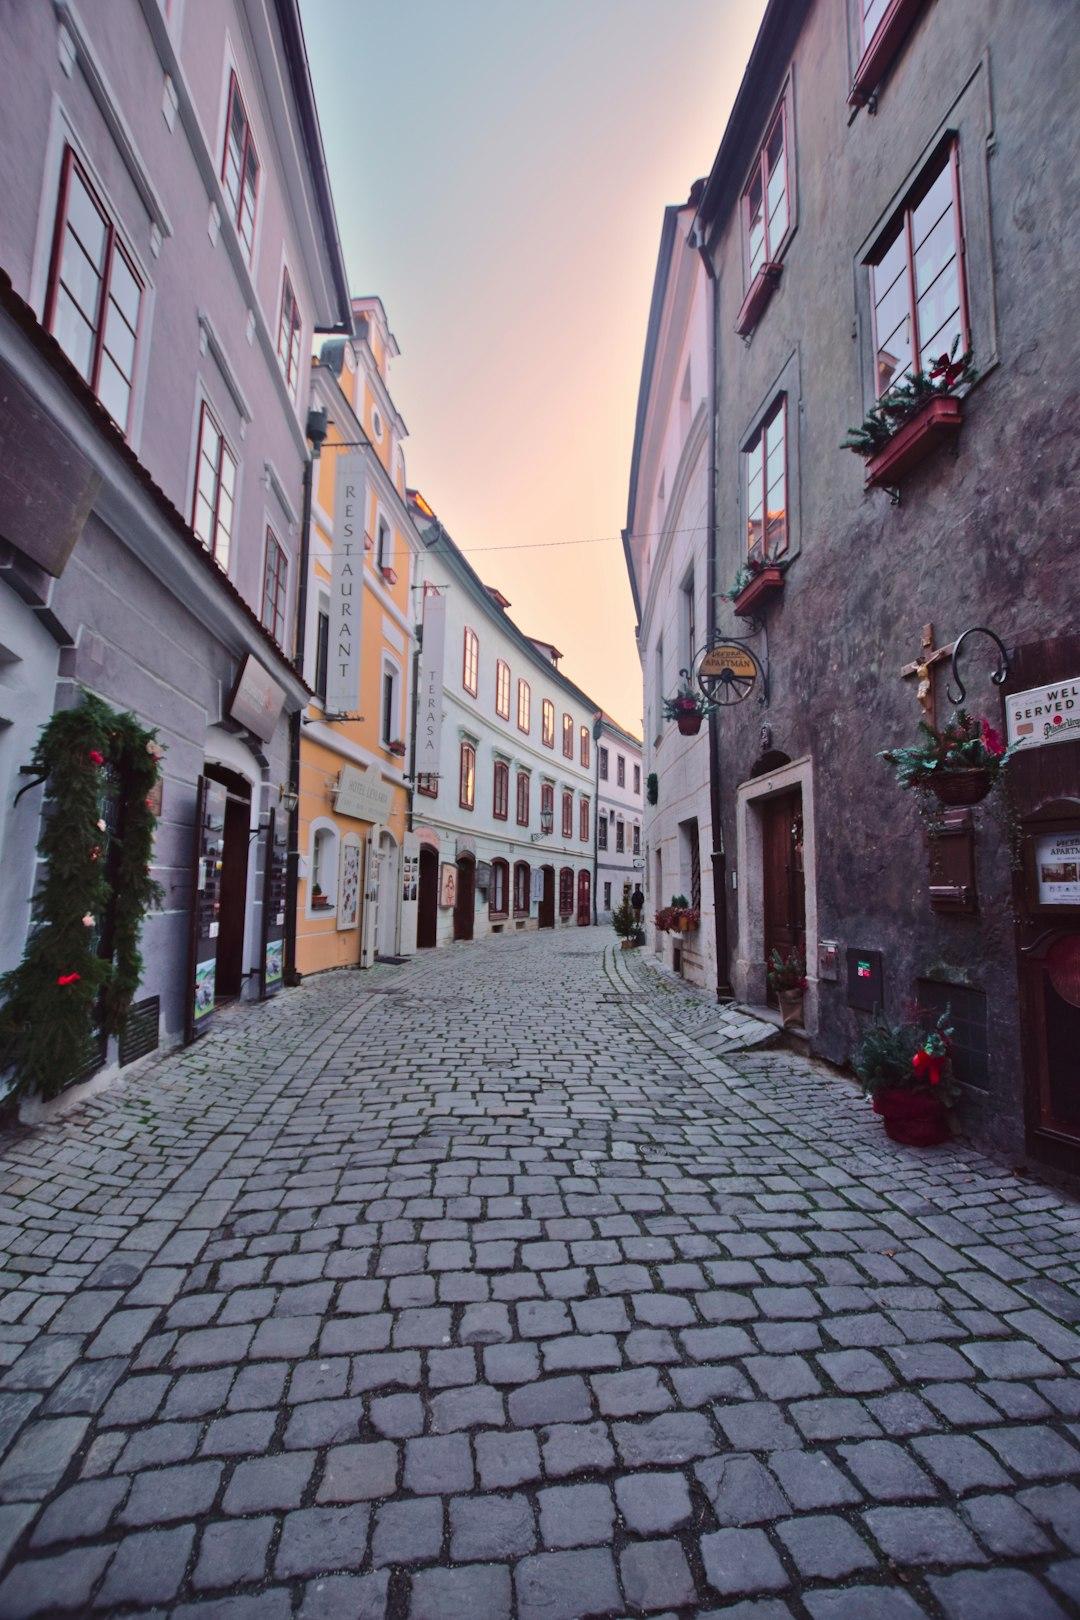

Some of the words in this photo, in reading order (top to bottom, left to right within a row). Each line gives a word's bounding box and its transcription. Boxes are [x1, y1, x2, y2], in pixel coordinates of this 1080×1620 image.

[338, 484, 356, 678] RESTAURANT
[425, 671, 437, 750] TERASA
[1015, 699, 1074, 721] SERVED
